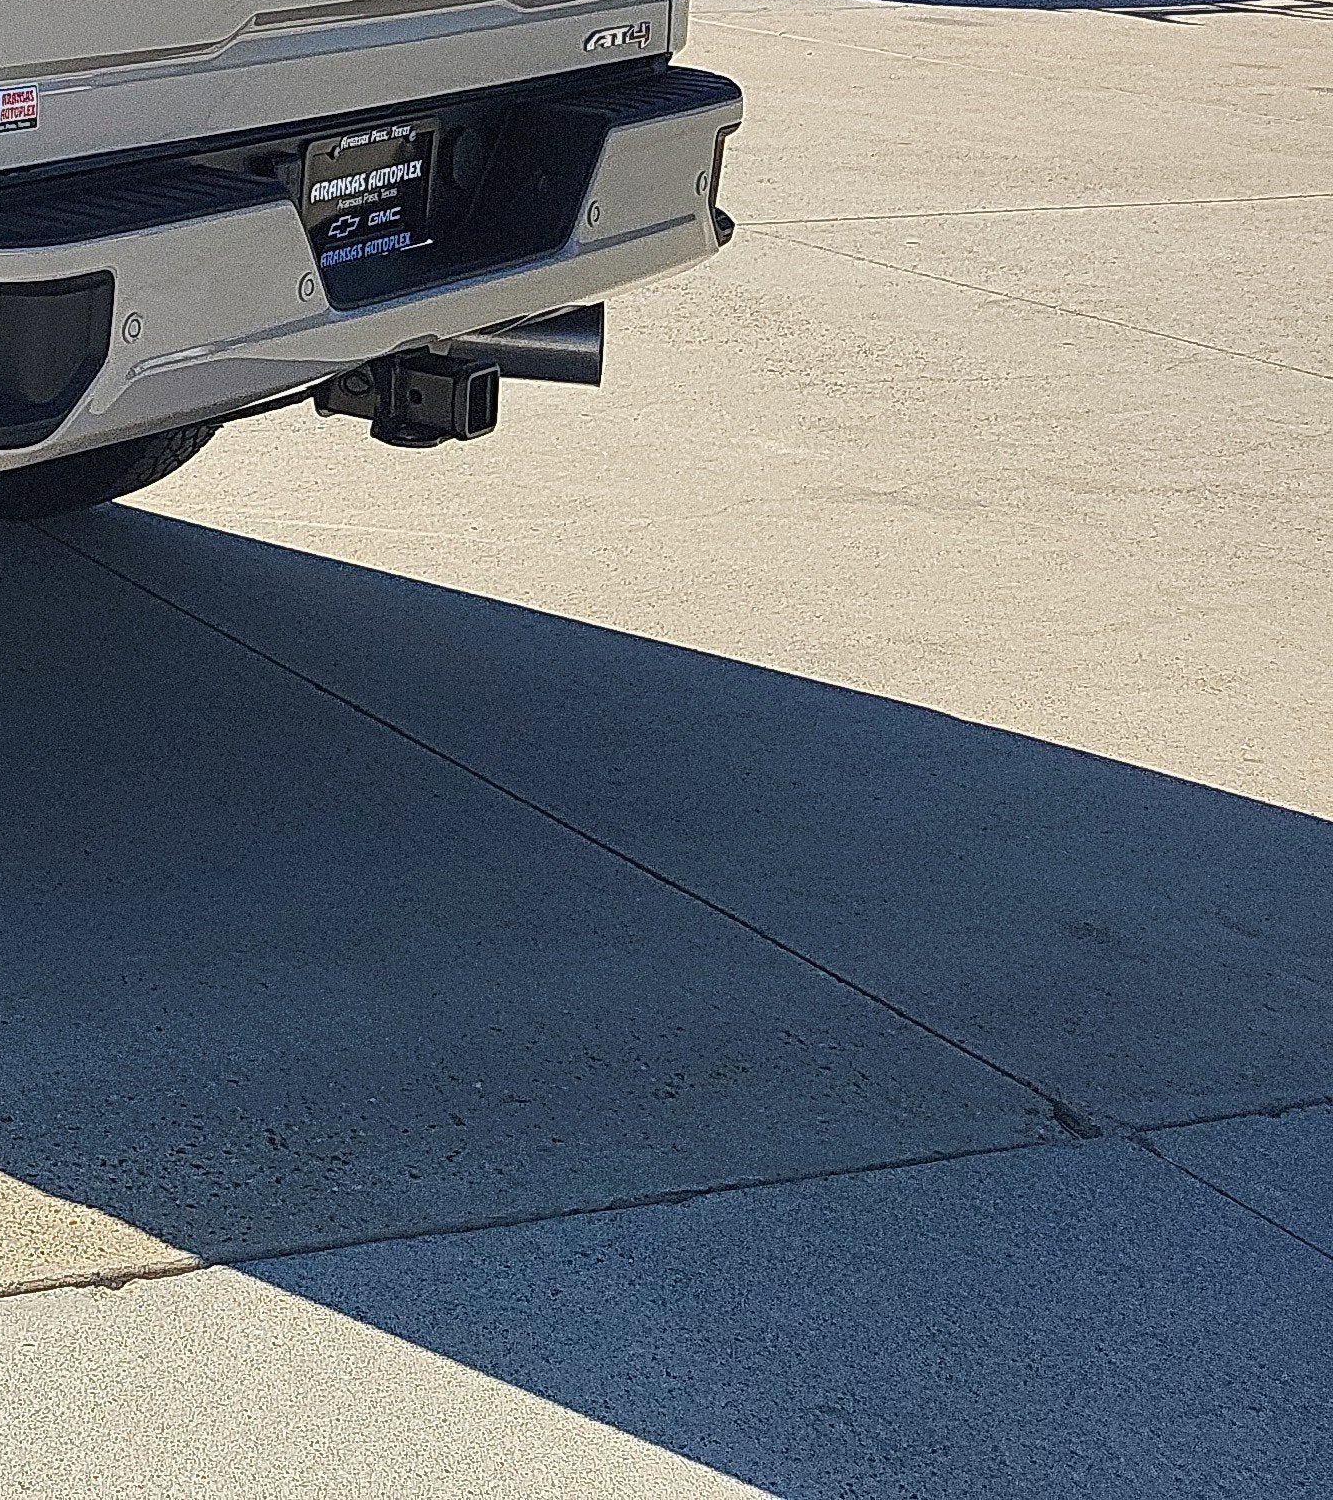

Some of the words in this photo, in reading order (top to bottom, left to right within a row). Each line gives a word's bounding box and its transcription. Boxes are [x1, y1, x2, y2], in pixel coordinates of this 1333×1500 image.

[584, 22, 652, 52] AT4
[310, 173, 367, 204] ARANSAS
[368, 160, 423, 192] AUTOPLEX
[368, 207, 401, 227] GMC
[320, 243, 363, 268] ARANSAS
[364, 231, 411, 257] AUTOPLEX
